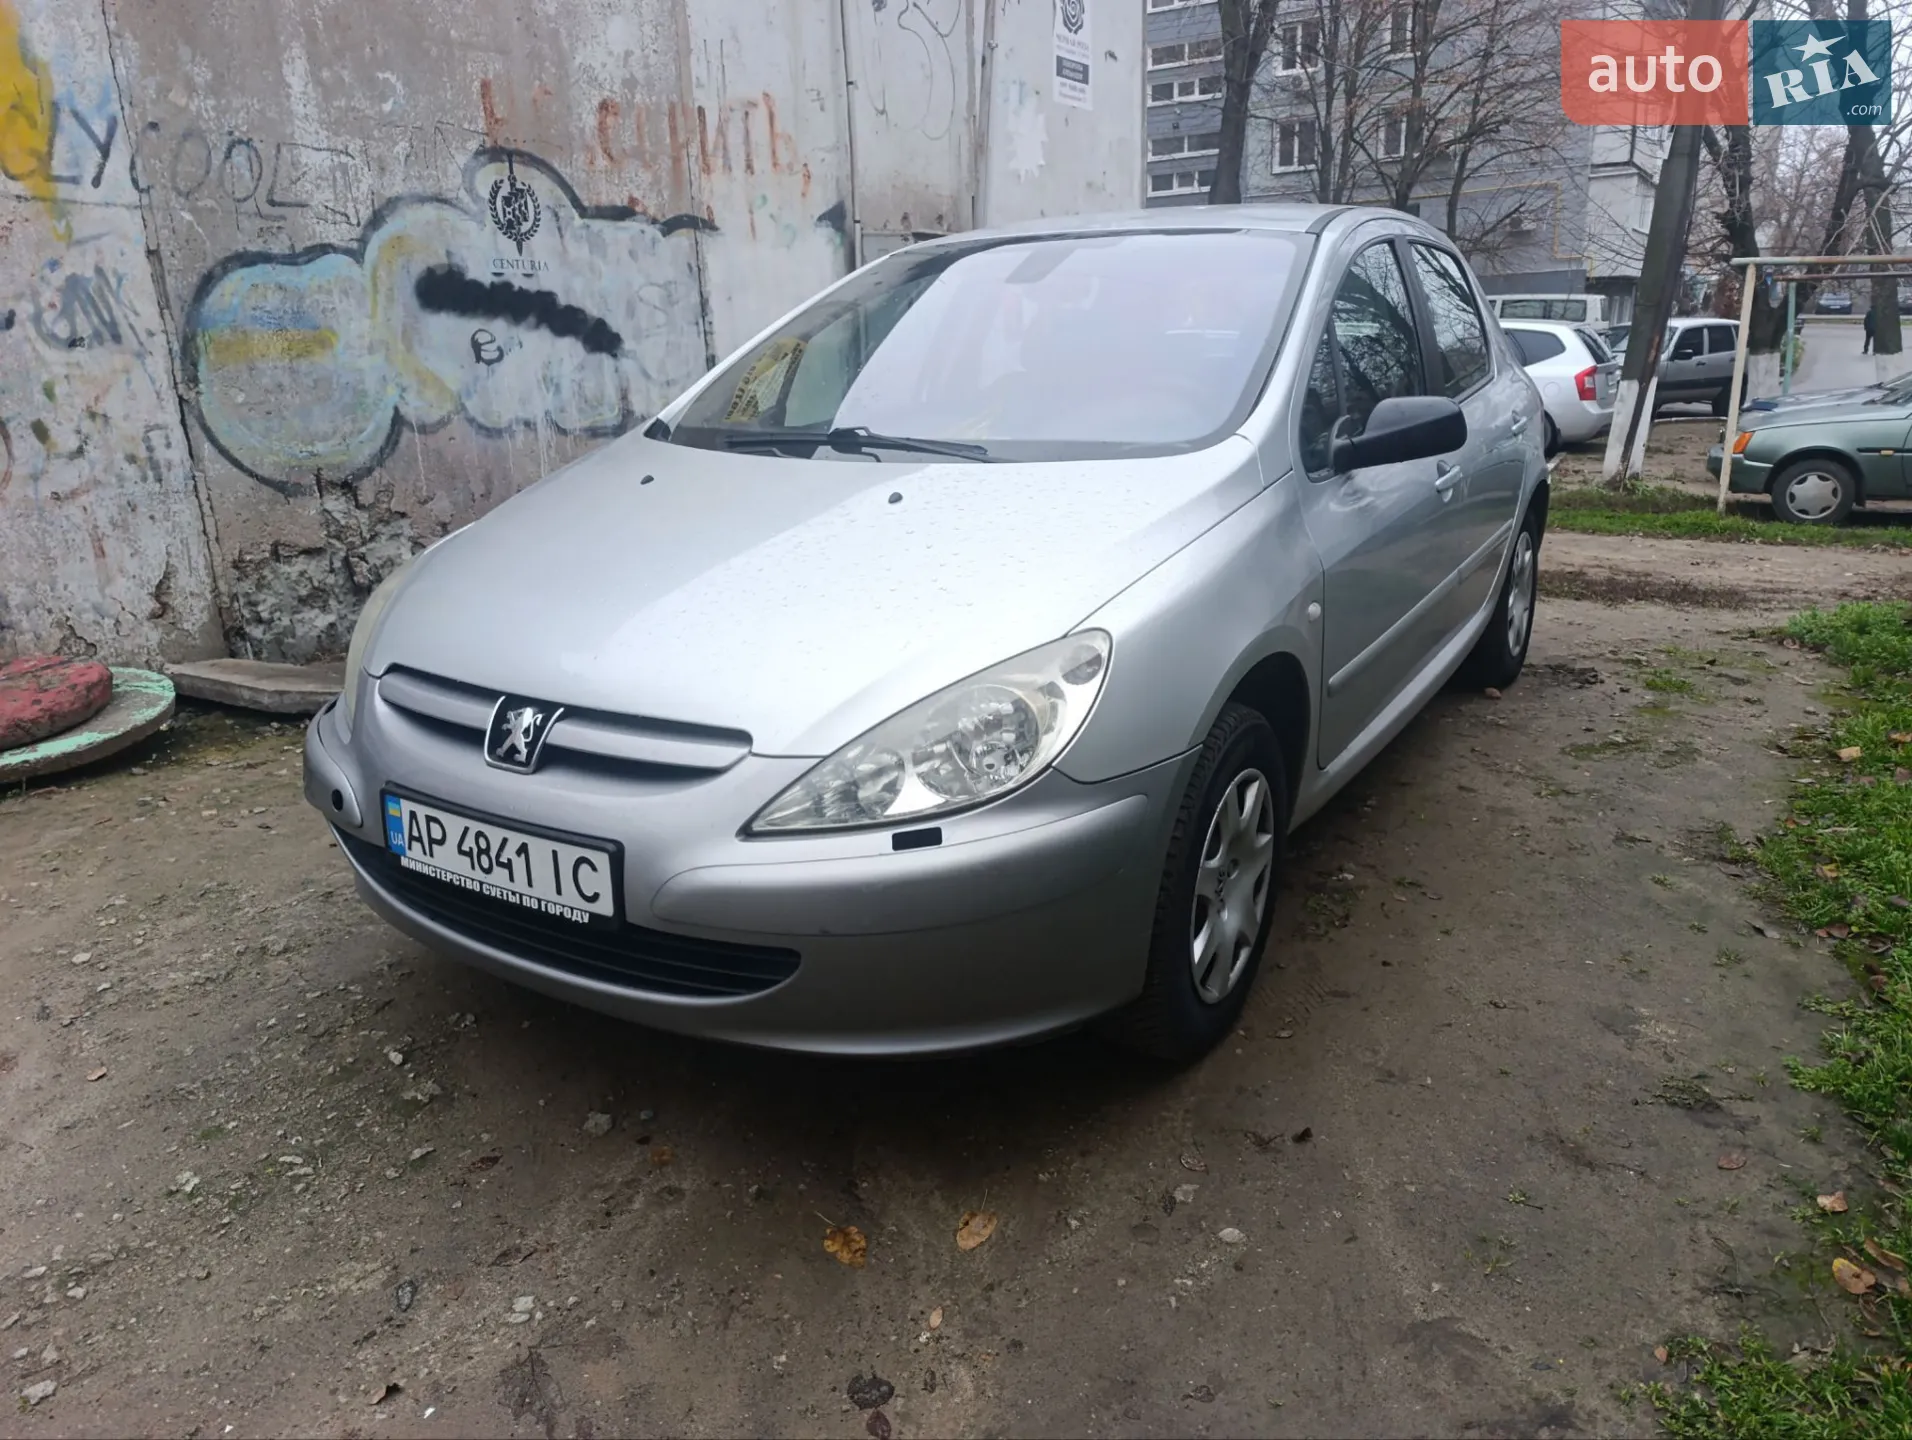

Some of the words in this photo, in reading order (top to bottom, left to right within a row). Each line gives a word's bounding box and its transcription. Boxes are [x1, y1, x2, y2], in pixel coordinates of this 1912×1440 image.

[492, 258, 550, 272] CENTURIA
[390, 831, 405, 847] UA
[407, 810, 447, 859] AP
[457, 825, 533, 889] 4841
[552, 849, 601, 904] IC
[400, 856, 481, 892] МИНИСТЕРСТВО
[482, 883, 520, 903] СУЕТЫ
[522, 894, 539, 910] ПО
[540, 900, 591, 924] ГОРОДУ
